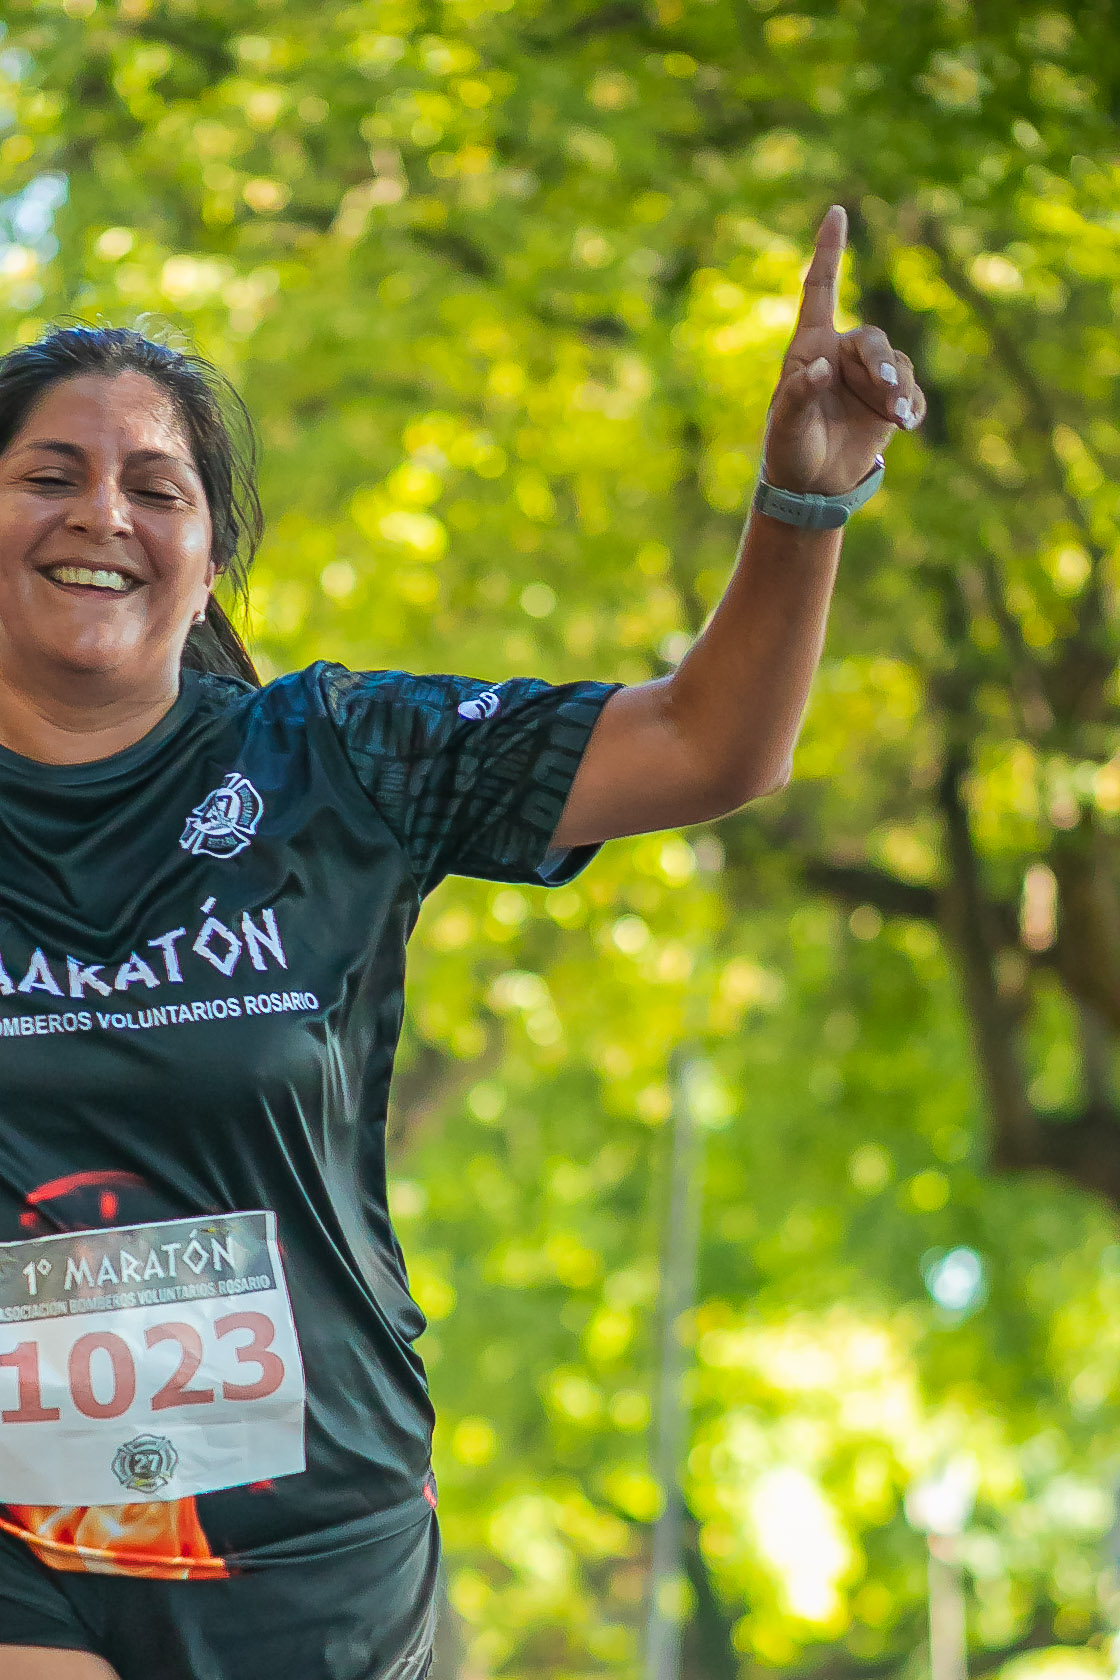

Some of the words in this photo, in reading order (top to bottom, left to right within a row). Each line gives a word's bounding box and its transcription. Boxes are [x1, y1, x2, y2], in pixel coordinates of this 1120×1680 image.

[96, 997, 242, 1030] VOLUNTARIOS
[243, 991, 319, 1016] ROSARIO
[64, 1228, 237, 1291] MARATÓN
[218, 1274, 271, 1296] ROSARIO
[134, 1453, 161, 1473] 27
